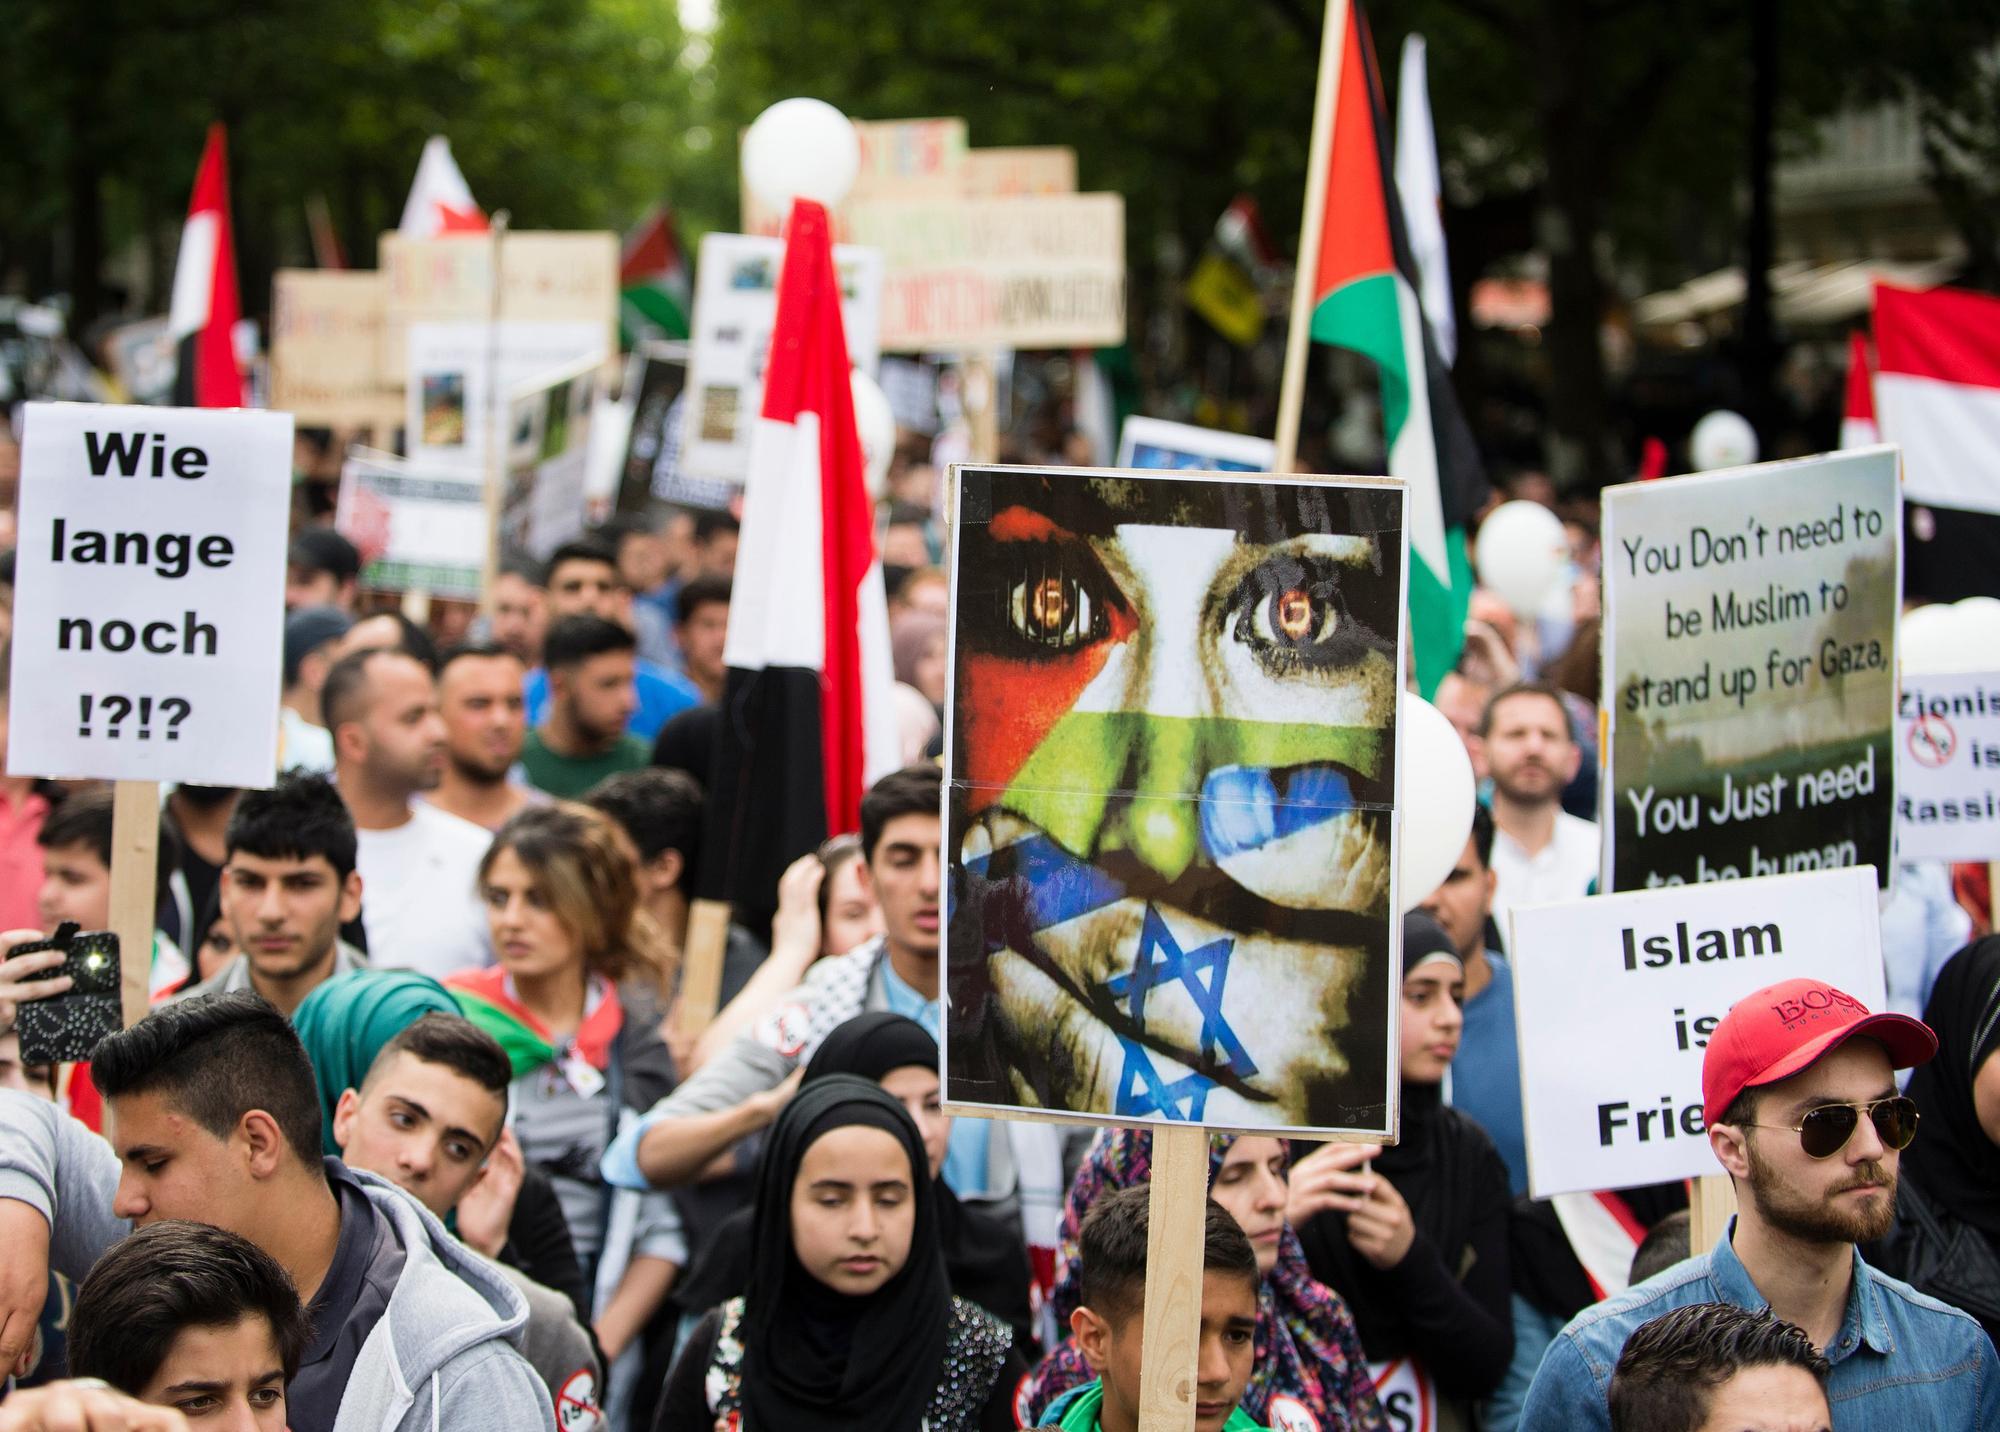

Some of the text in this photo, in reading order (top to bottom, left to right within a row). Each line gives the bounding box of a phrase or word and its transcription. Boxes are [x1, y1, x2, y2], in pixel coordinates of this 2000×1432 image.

[84, 432, 209, 479] Wie
[51, 518, 234, 579] lange
[1622, 503, 1883, 578] You Don't need to
[57, 611, 217, 655] noch
[1666, 579, 1849, 640] be Muslim to
[1625, 637, 1889, 712] stand up for Gaza,
[79, 694, 192, 741] !?!?
[1627, 744, 1875, 837] You Just need
[1898, 791, 2000, 823] Rassi
[1621, 921, 1783, 971] Islam
[1787, 1008, 1831, 1032] HUGO
